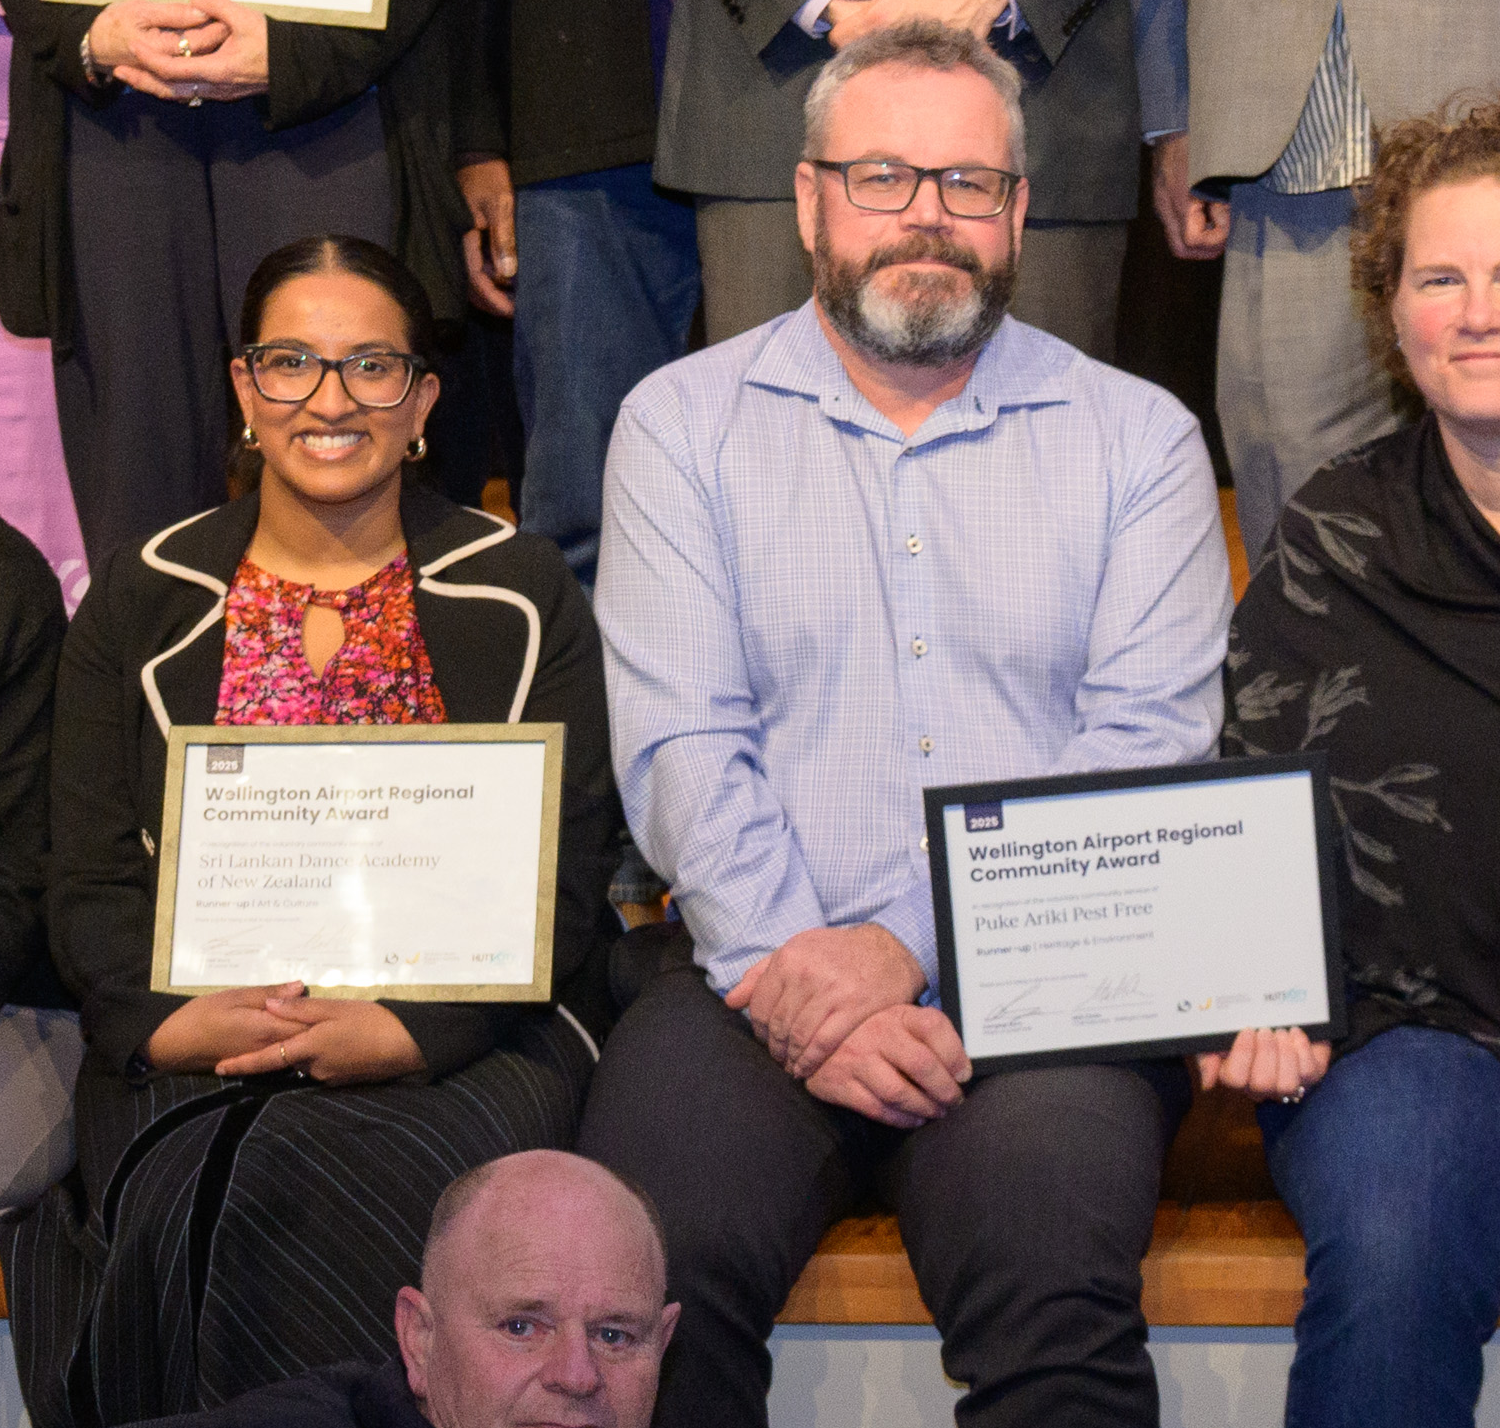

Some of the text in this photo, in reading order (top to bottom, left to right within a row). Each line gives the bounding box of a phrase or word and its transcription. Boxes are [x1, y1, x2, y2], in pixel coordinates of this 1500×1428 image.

[211, 760, 239, 771] 2025
[205, 785, 475, 804] Wellington Airport Regional
[203, 806, 390, 826] Community Award
[970, 815, 999, 829] 2025
[968, 820, 1243, 861] Wellington Airport Regional
[199, 853, 441, 870] Sri Lankan Dance Academy
[970, 850, 1161, 883] Community Award
[197, 874, 332, 889] of New Zealand
[196, 899, 250, 909] Runner-up
[975, 902, 1153, 932] Puke Ariki Pest Free
[977, 944, 1031, 956] Runner-up
